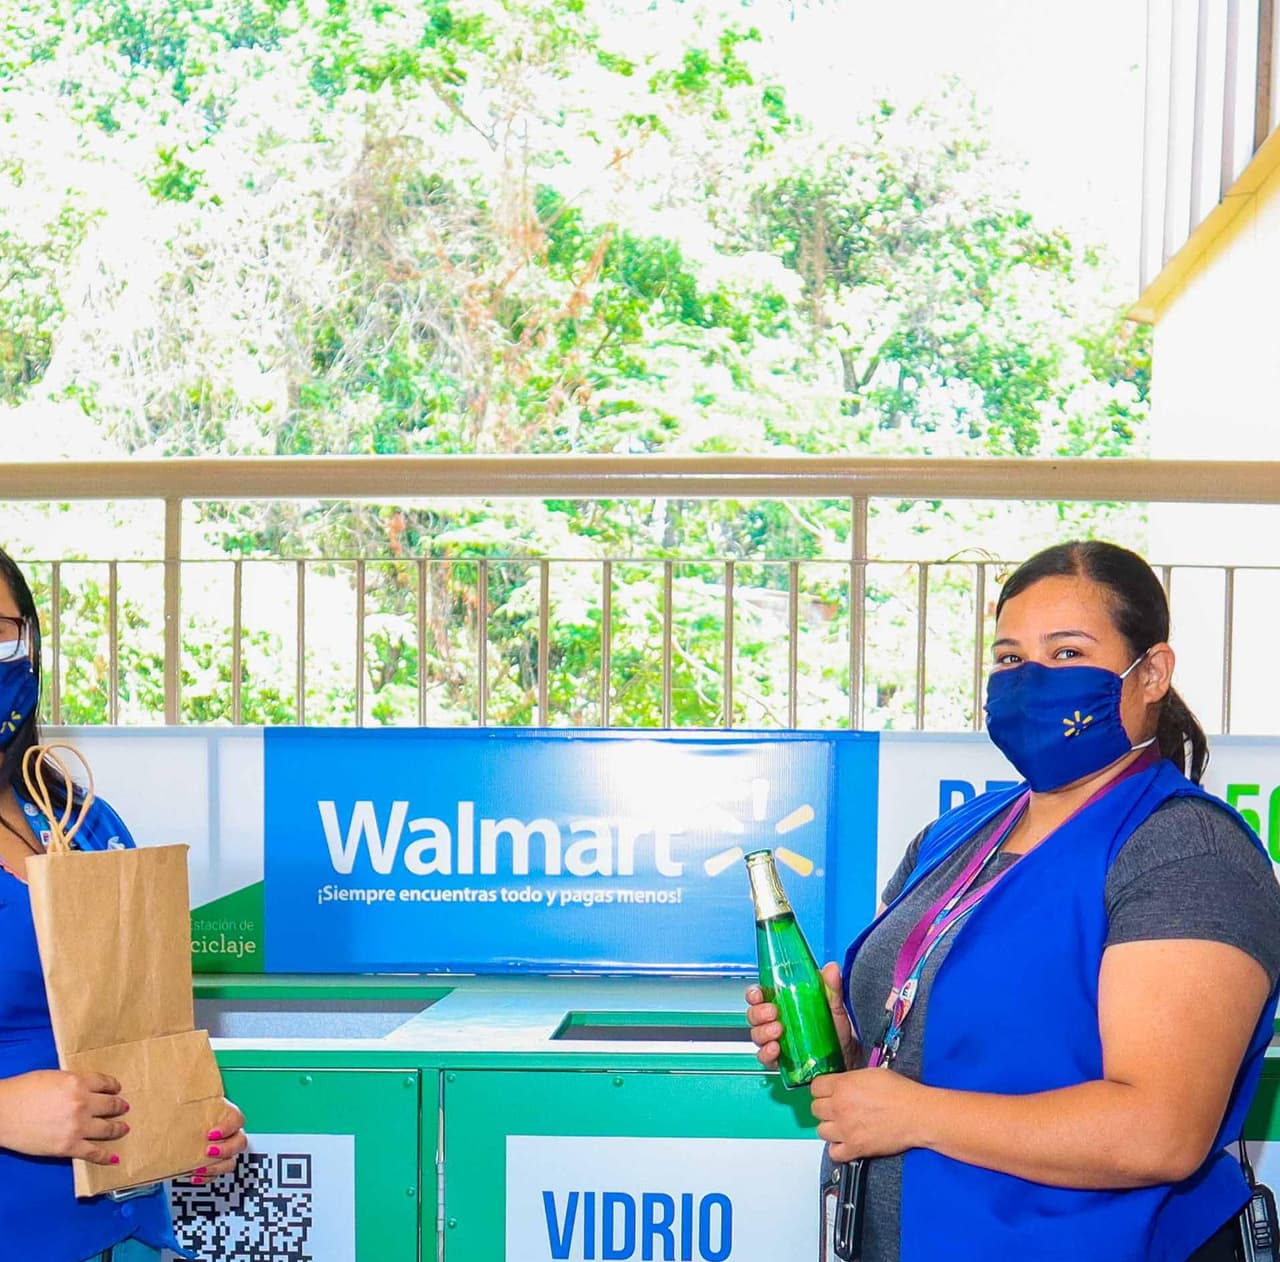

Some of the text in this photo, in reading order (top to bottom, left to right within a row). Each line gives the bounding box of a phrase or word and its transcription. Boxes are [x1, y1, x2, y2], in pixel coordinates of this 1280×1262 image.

[317, 800, 685, 877] Walmart
[318, 884, 683, 907] ¡Siempre encuentras todo y pagas menos!
[190, 917, 255, 931] stación de
[190, 933, 257, 958] ciclaje
